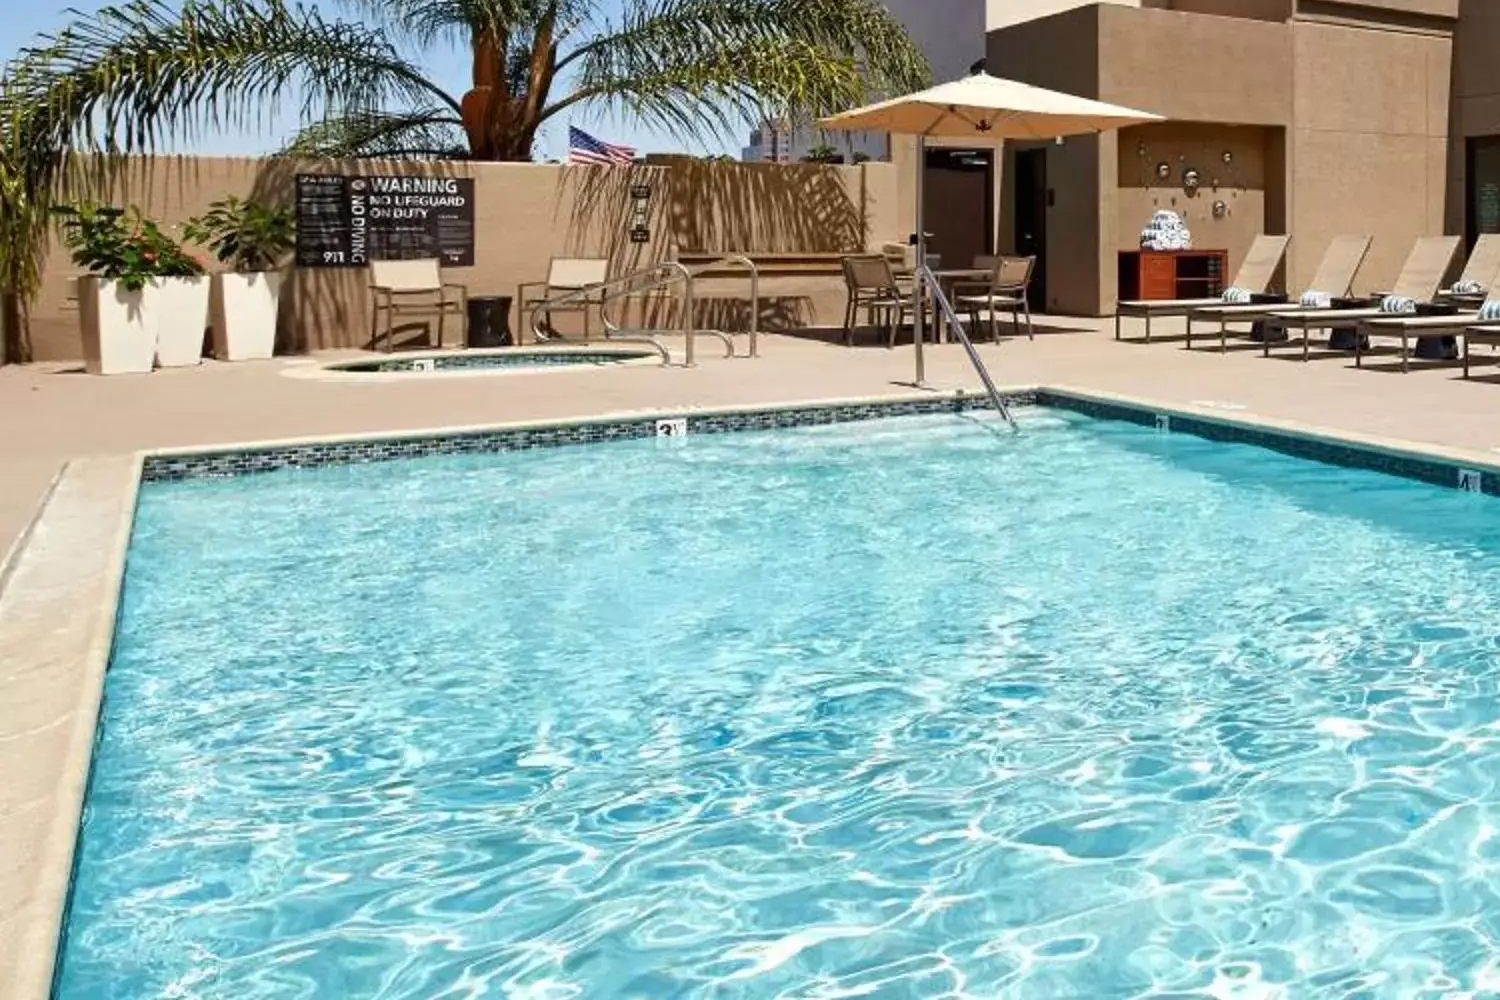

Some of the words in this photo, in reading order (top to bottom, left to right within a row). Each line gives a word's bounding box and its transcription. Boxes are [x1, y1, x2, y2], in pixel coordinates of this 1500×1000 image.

[370, 178, 458, 193] WARNING
[351, 195, 366, 215] NO
[369, 195, 391, 205] NO
[395, 195, 465, 207] LIFEGUARD
[369, 207, 391, 219] ON
[394, 207, 428, 219] DUTY
[351, 217, 366, 263] DIVING
[323, 251, 346, 263] 911
